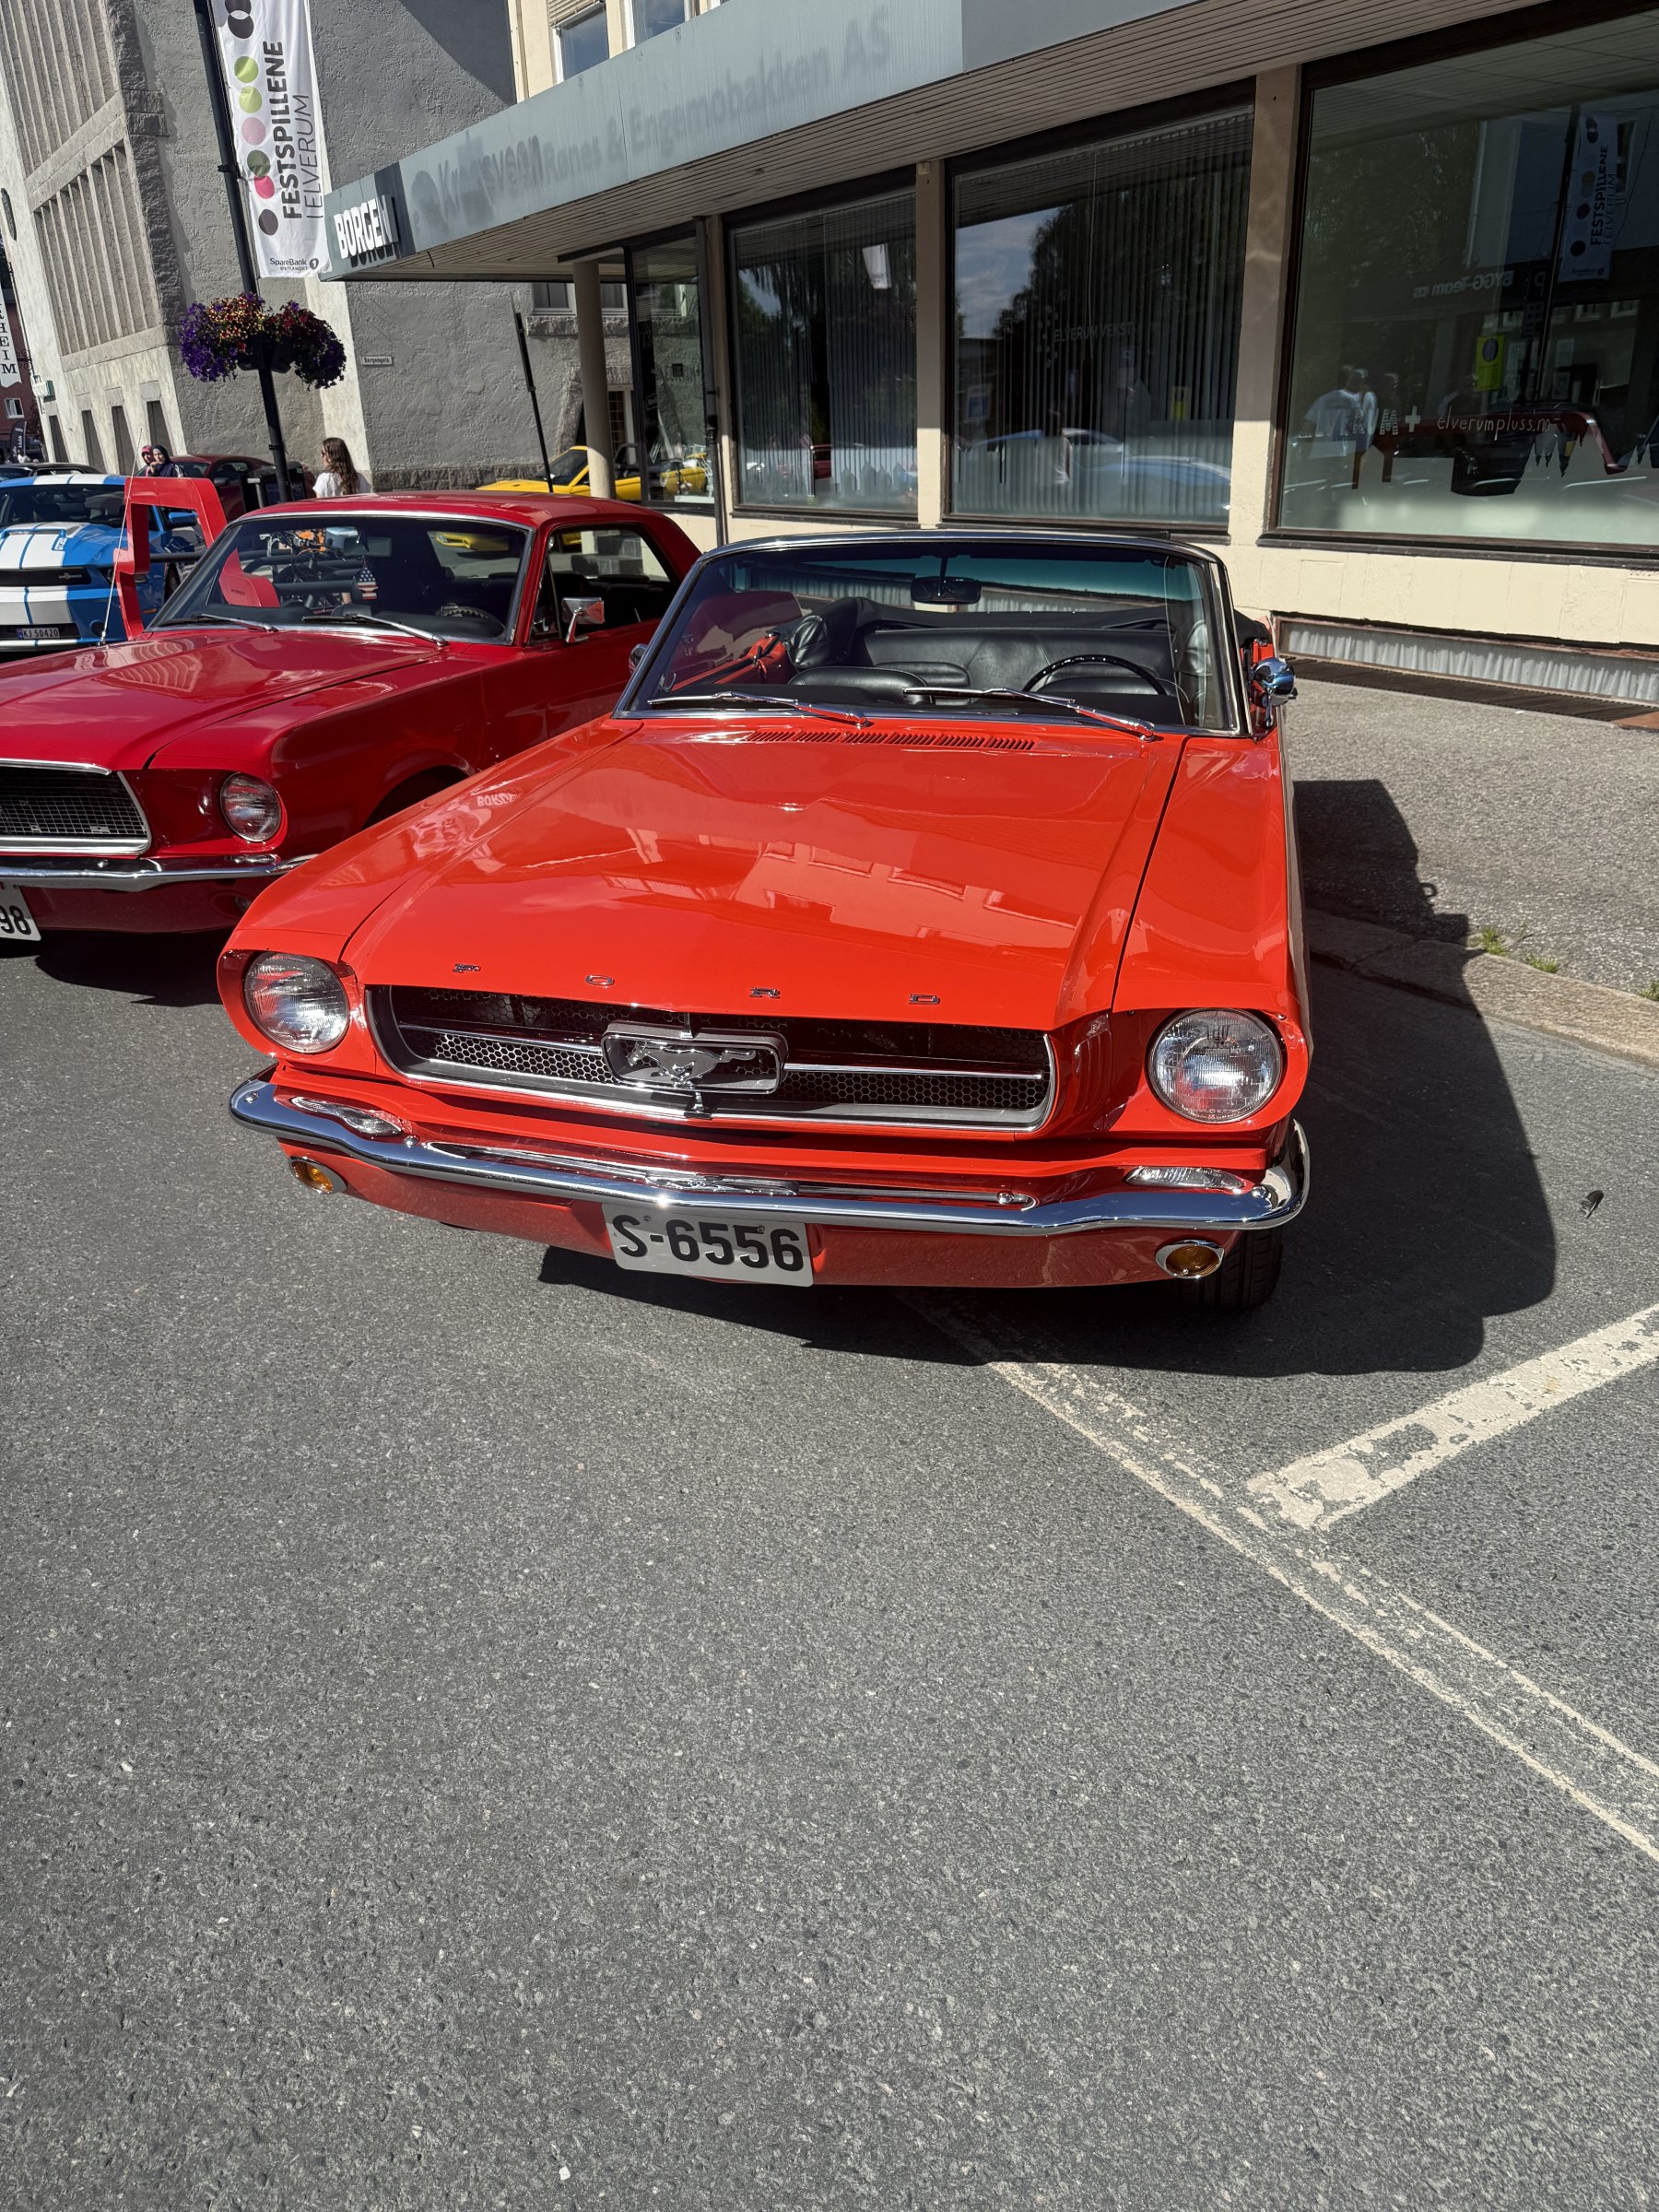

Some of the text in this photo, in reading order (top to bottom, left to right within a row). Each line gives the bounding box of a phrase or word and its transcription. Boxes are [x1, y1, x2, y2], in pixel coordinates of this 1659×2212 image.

[263, 41, 302, 219] FESTSPILLENE
[334, 194, 399, 259] BORGEN
[269, 257, 308, 266] SpareBank
[1436, 406, 1551, 441] elverumpluss.no
[612, 1214, 805, 1272] S-6556
